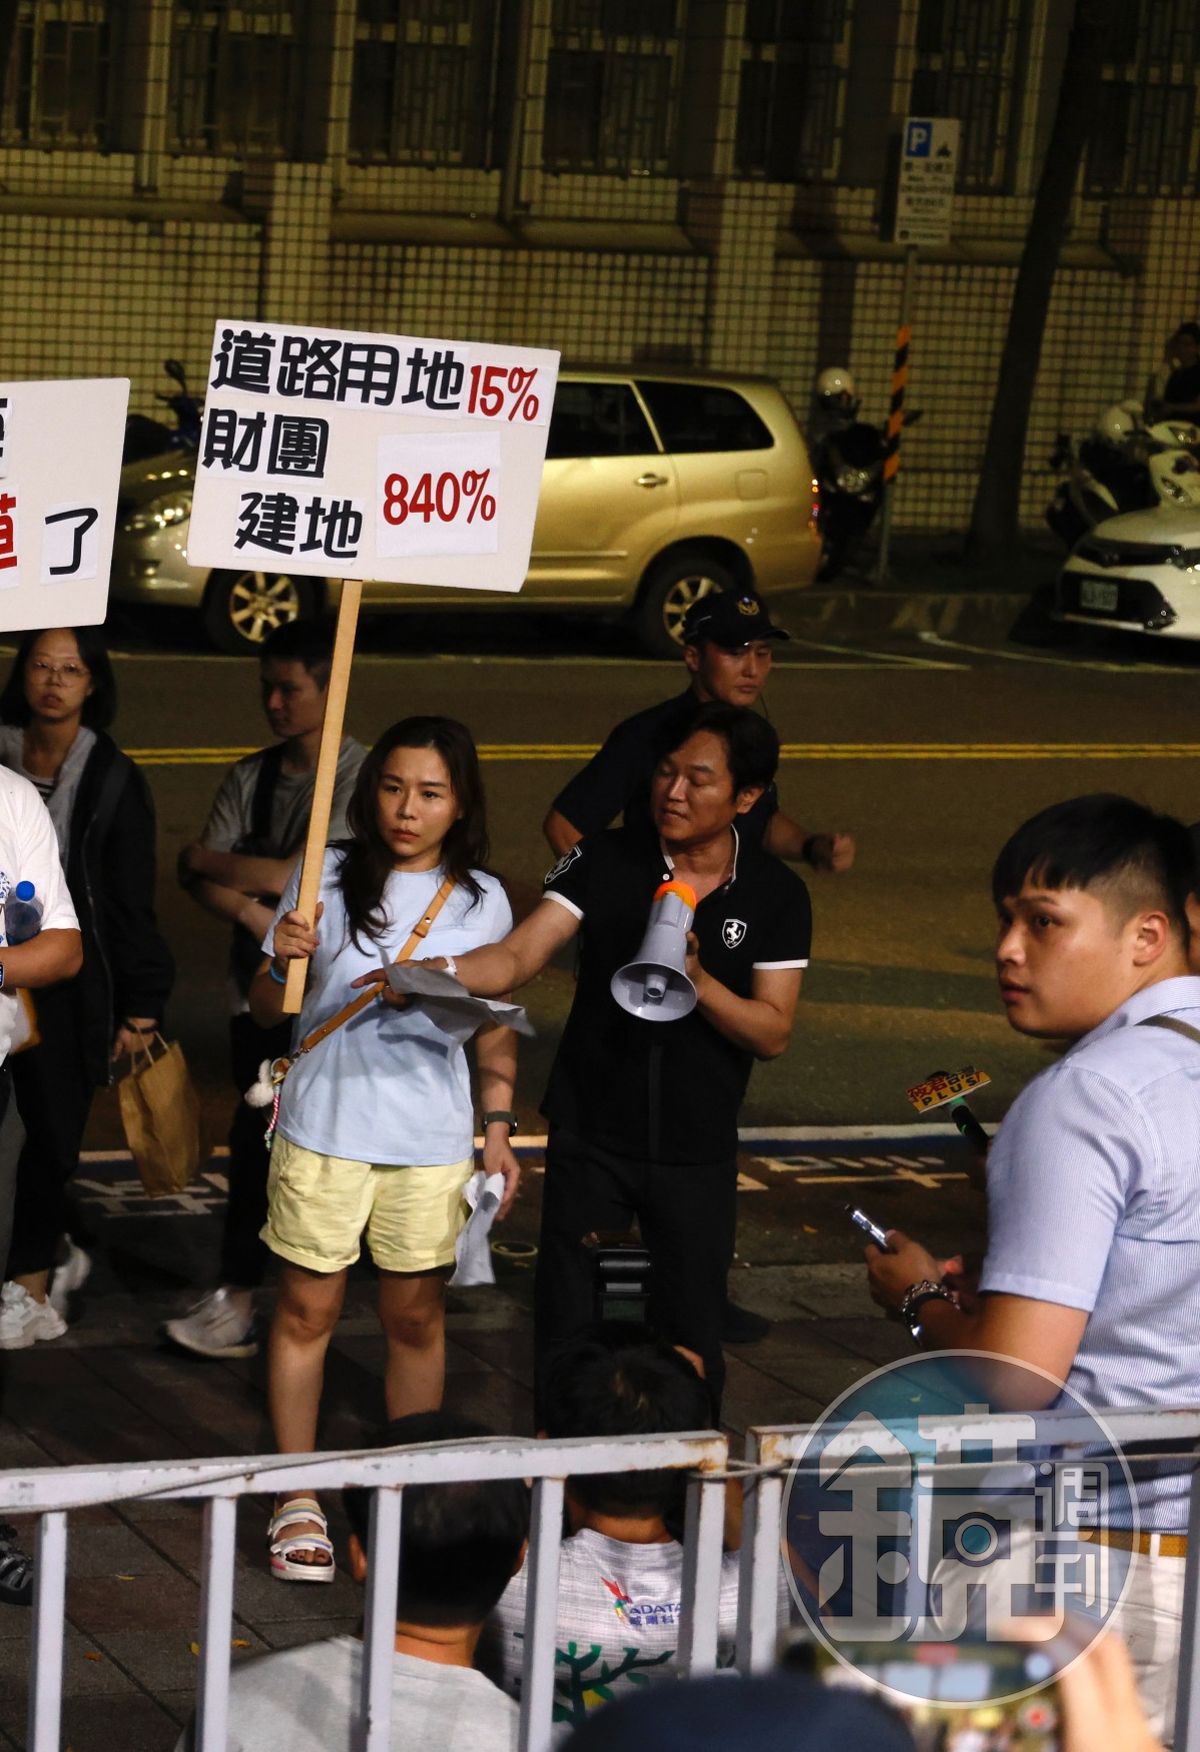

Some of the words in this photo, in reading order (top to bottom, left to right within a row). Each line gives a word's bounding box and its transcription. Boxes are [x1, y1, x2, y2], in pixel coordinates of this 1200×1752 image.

[911, 127, 927, 152] P
[202, 407, 330, 479] 財團
[44, 507, 99, 576] 了
[234, 492, 364, 559] 建地
[383, 468, 497, 526] 840%
[921, 1077, 978, 1106] PLUS
